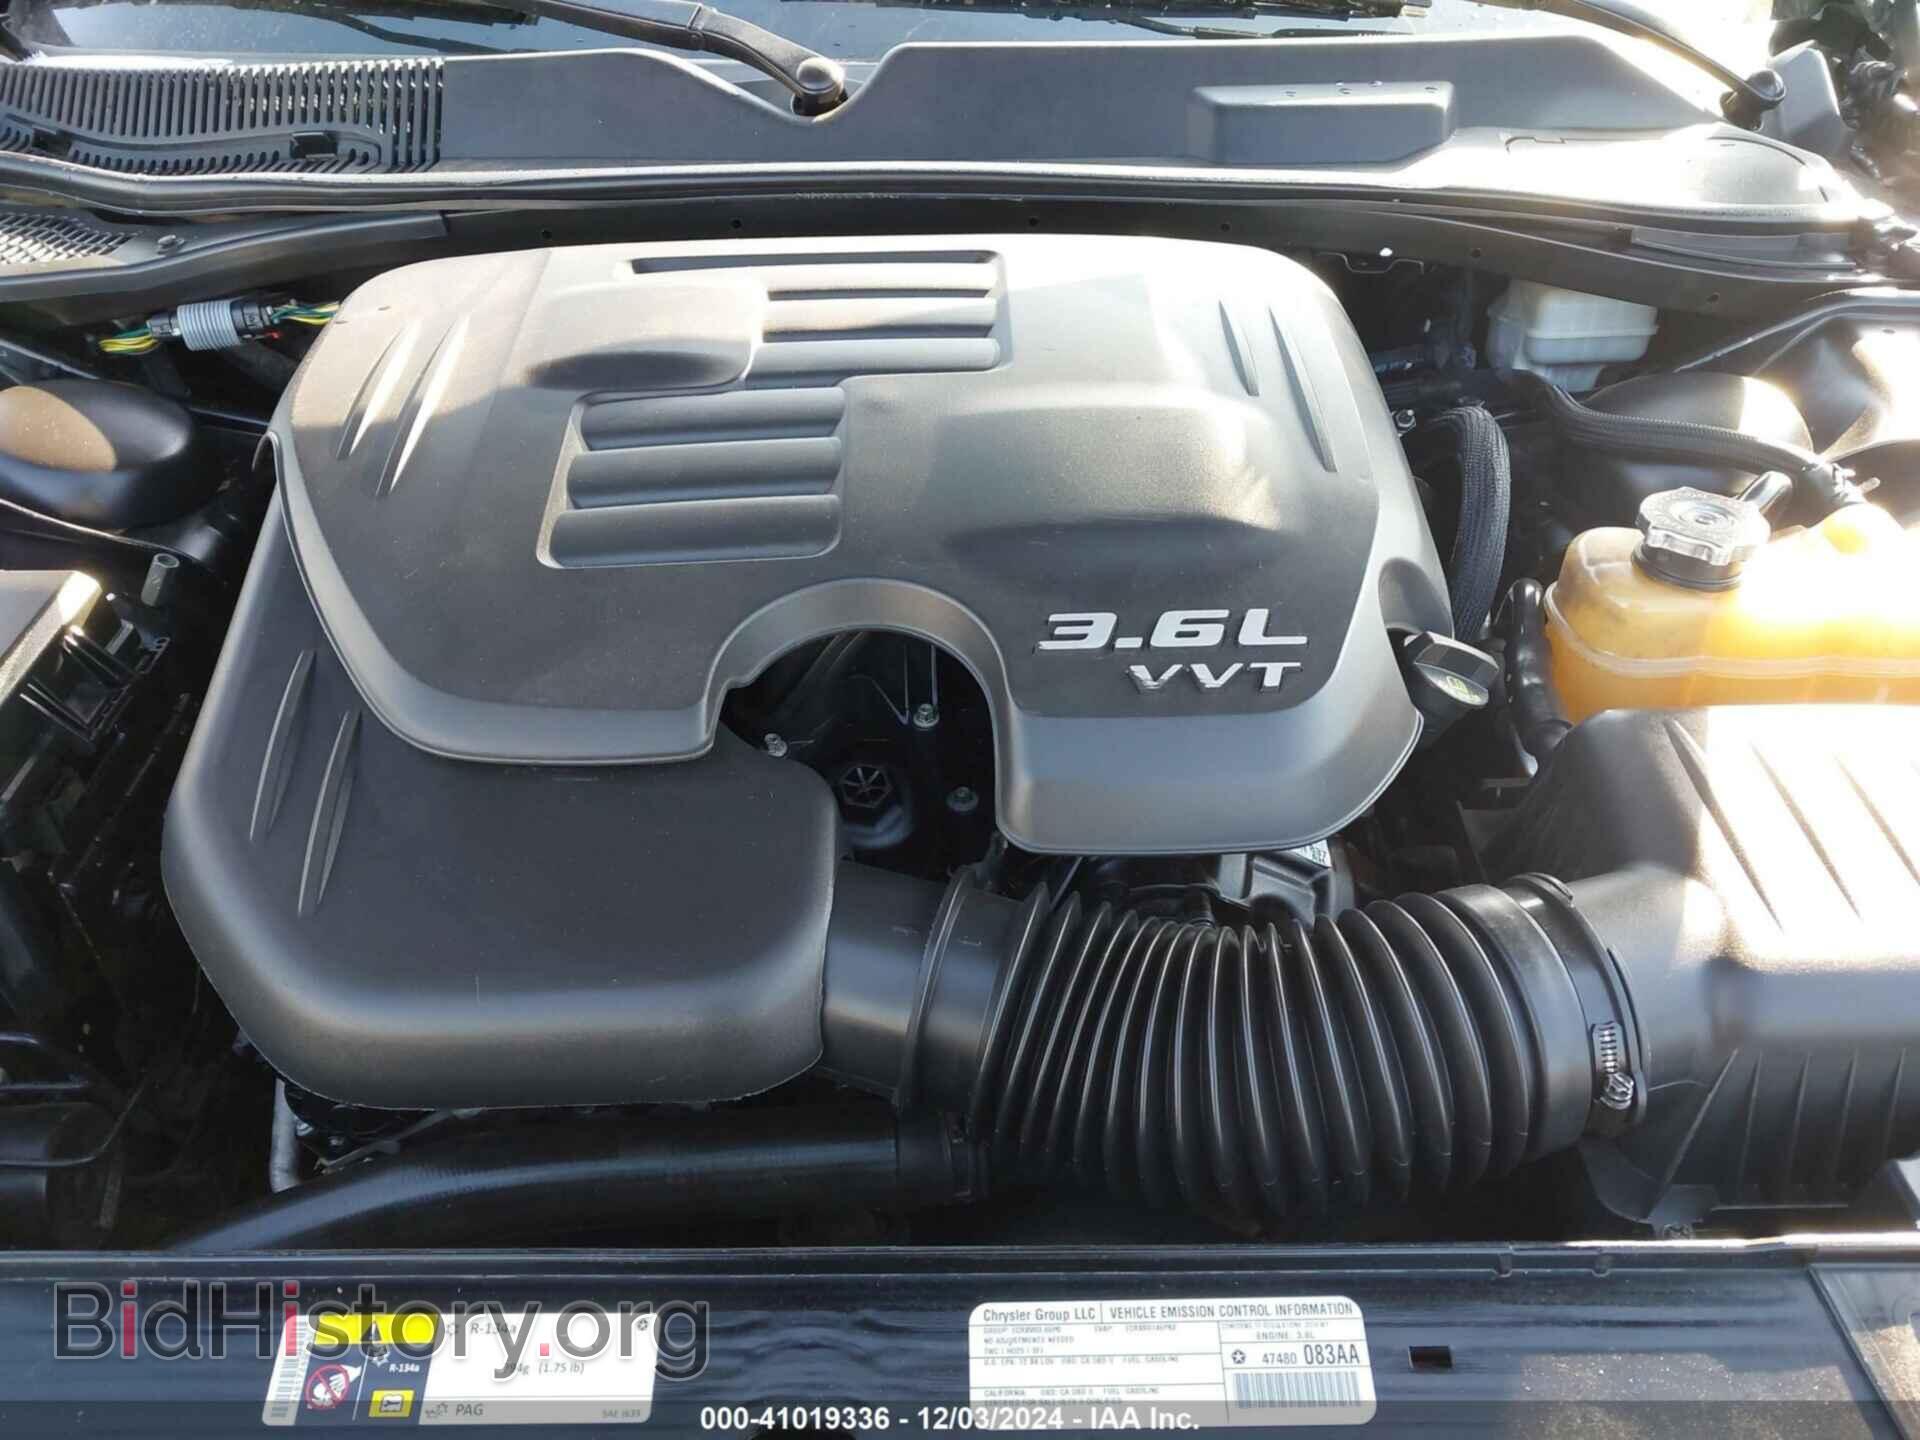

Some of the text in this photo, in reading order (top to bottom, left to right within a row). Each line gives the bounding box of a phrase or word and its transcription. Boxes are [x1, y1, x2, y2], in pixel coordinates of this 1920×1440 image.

[1037, 608, 1308, 650] 3.6L
[1127, 662, 1302, 690] VVT
[983, 1307, 1096, 1325] Chrysler Group LLC
[1110, 1302, 1353, 1319] VEHICLE EMISSION CONTROL INFORMATION
[1303, 1343, 1361, 1365] 083AA
[455, 1403, 485, 1416] PAG
